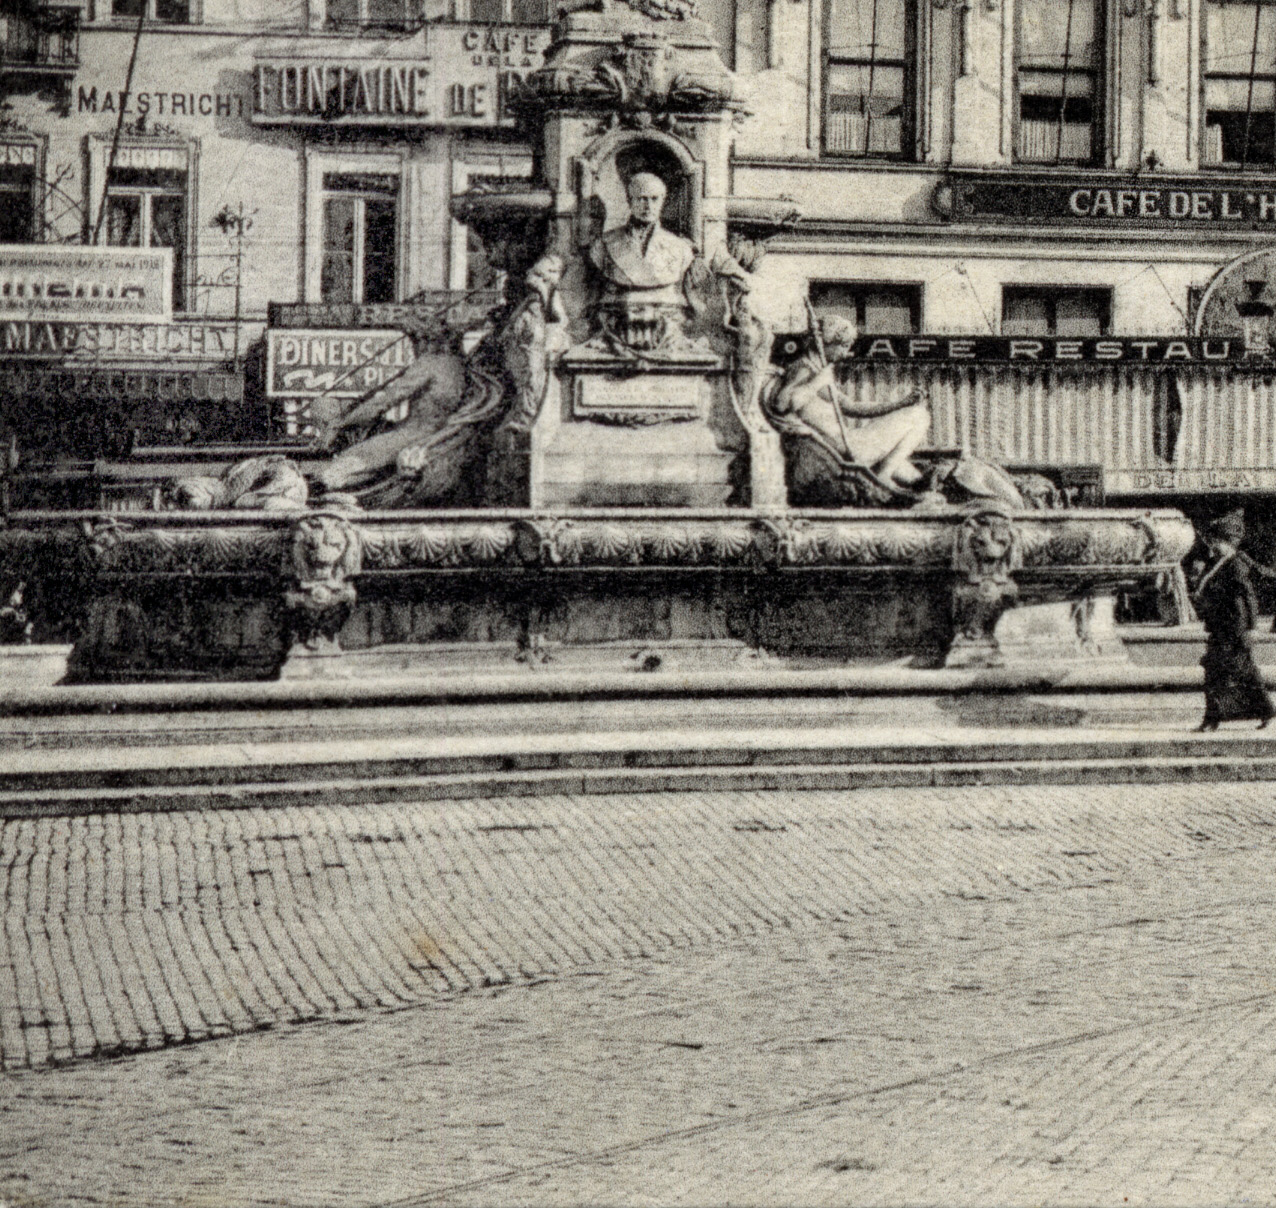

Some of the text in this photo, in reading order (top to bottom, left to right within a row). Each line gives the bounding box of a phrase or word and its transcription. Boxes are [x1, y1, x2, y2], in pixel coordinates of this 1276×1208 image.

[77, 85, 246, 117] MAESTRICHT
[252, 64, 431, 119] FONTAINE
[1069, 191, 1162, 217] CAFE
[1168, 192, 1214, 221] DE
[842, 339, 978, 359] AFE
